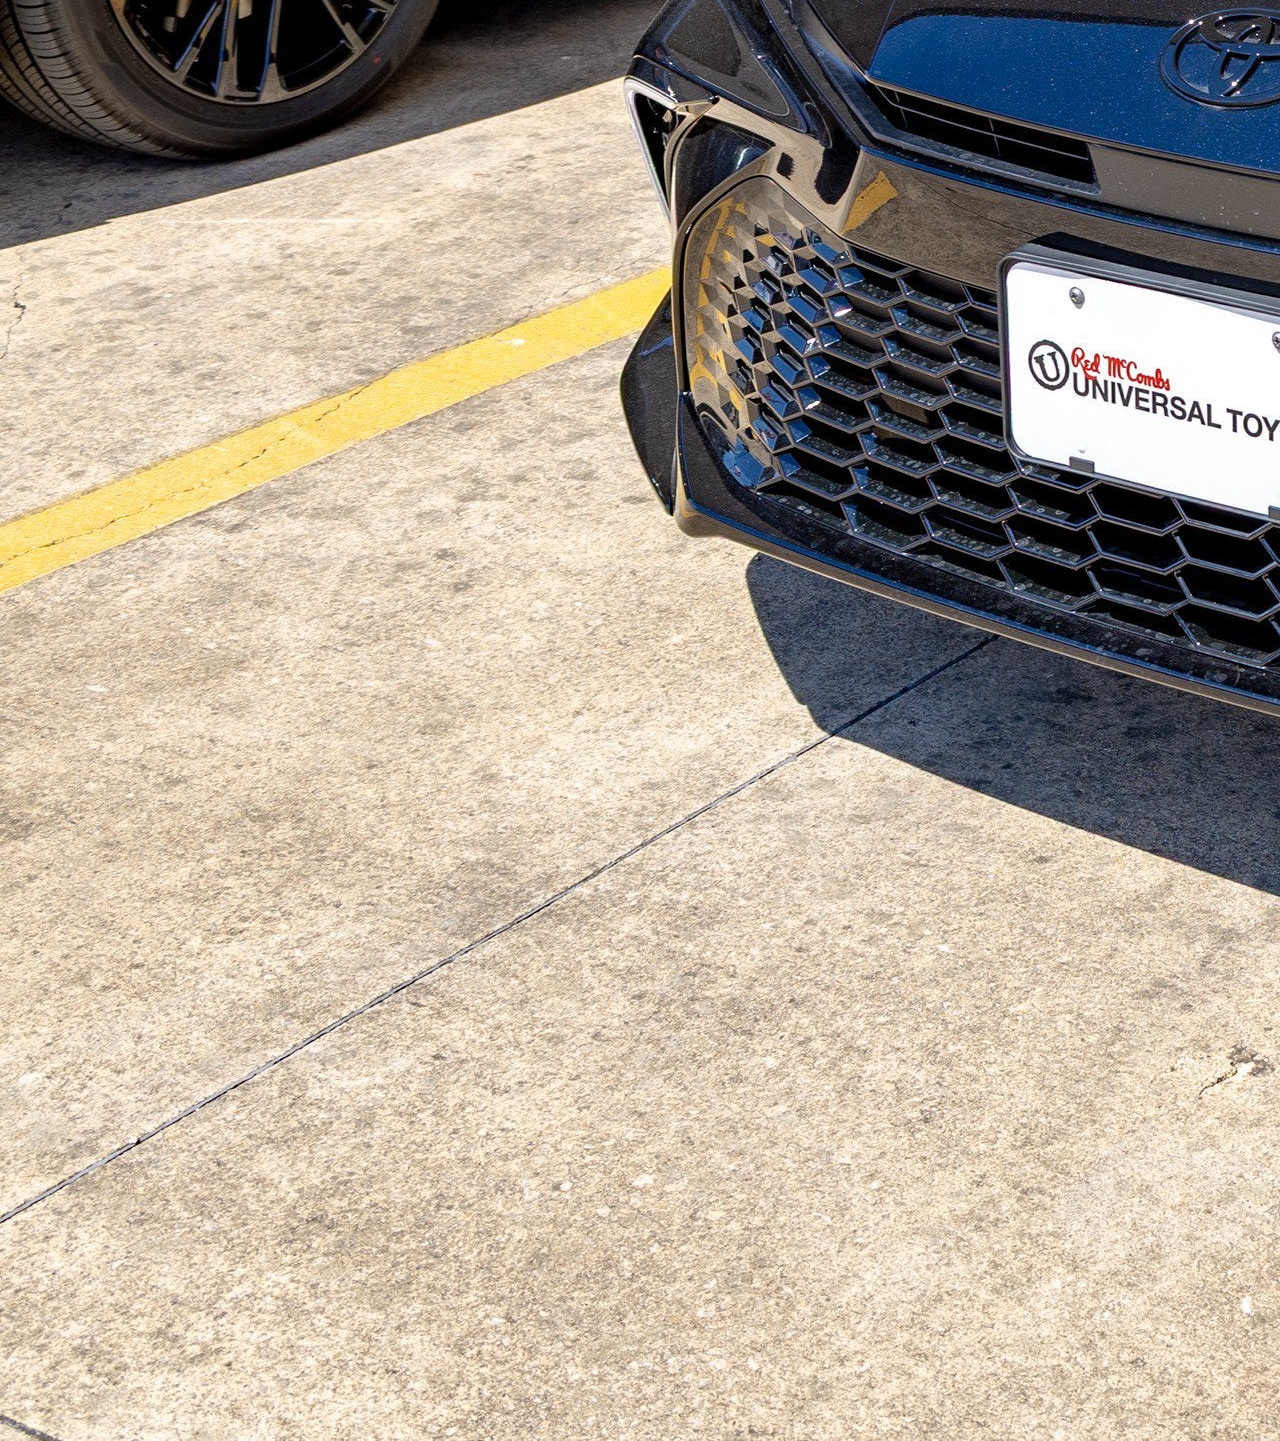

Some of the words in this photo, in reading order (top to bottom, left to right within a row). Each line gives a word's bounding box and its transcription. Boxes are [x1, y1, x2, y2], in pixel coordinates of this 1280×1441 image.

[1071, 346, 1100, 381] Red
[1102, 353, 1171, 392] McCombs
[1072, 371, 1222, 430] UNIVERSAL
